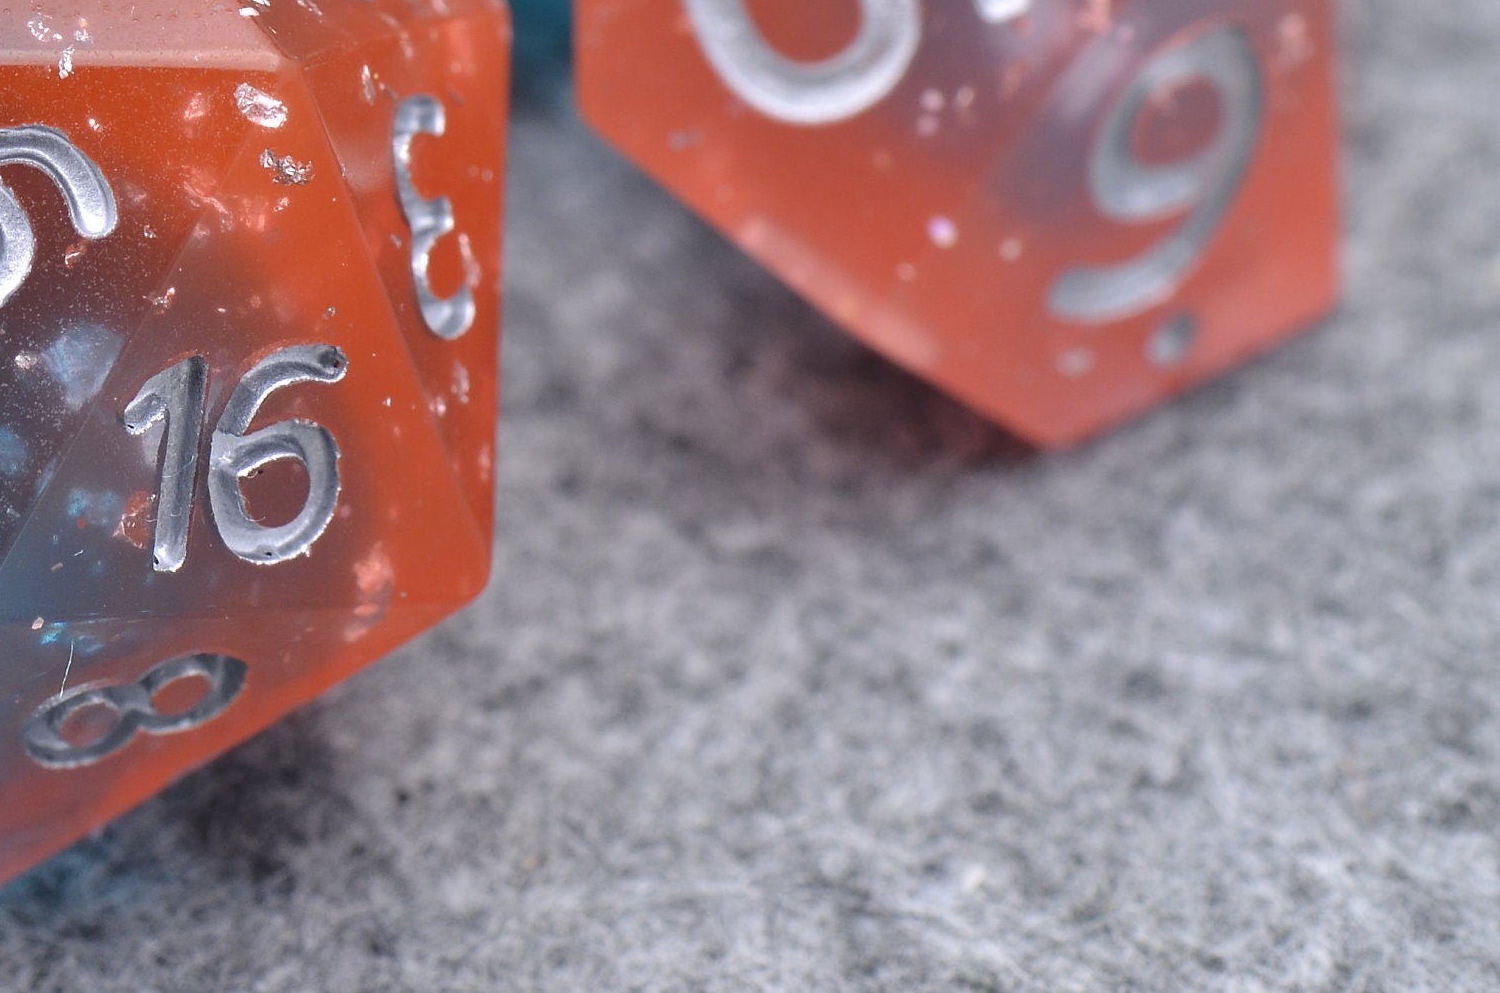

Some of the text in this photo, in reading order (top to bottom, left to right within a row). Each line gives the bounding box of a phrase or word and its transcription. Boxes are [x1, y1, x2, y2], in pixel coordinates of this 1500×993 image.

[391, 93, 478, 342] 3
[1044, 18, 1265, 326] 9
[123, 342, 349, 573] 16
[22, 650, 250, 770] 8
